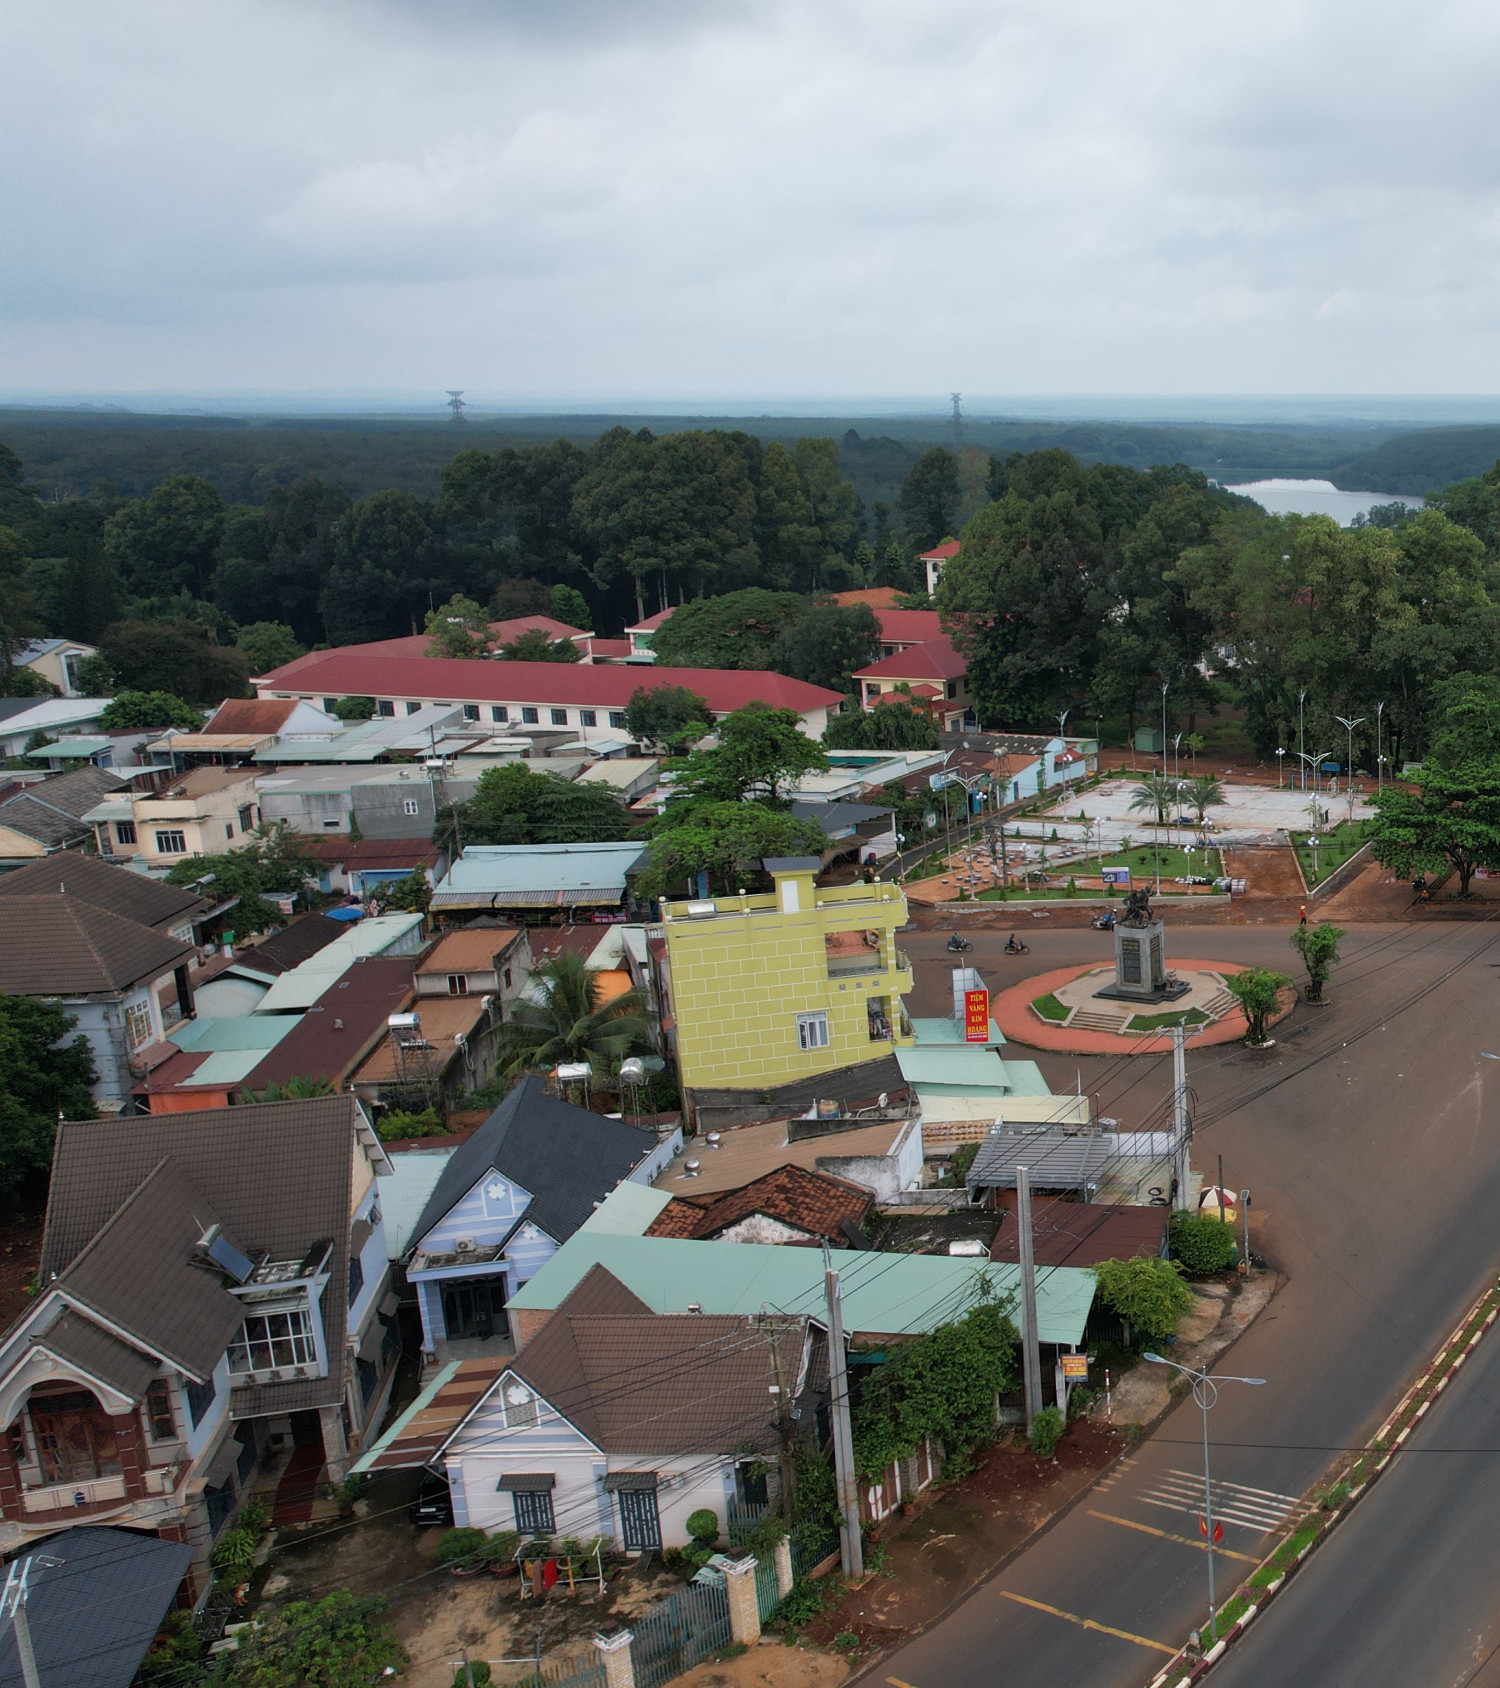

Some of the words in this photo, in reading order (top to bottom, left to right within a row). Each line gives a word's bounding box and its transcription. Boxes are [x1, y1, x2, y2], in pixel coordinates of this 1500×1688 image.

[969, 992, 984, 1003] TIỆM
[969, 1003, 985, 1012] VÀNG
[971, 1015, 983, 1023] KIM
[967, 1023, 988, 1033] HOÀNG
